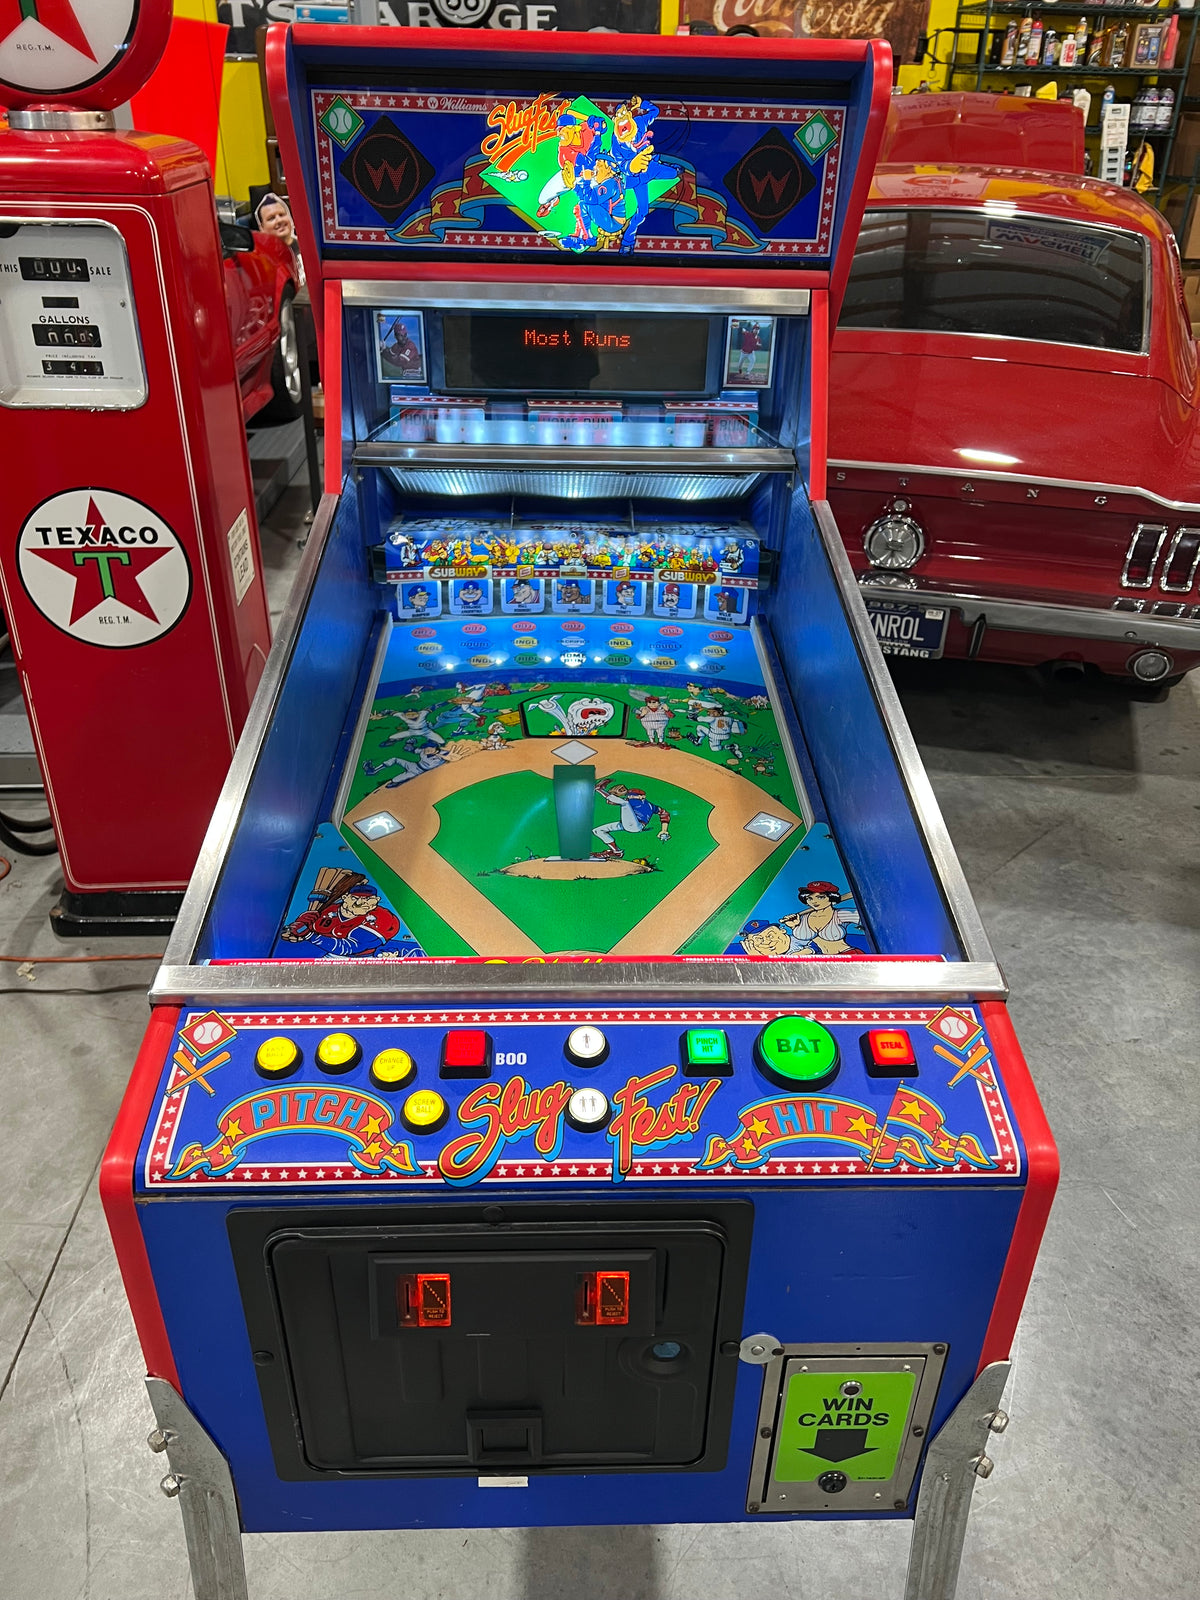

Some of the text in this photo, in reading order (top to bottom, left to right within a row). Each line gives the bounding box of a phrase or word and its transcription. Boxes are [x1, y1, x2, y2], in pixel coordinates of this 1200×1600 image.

[439, 96, 488, 111] Williams
[90, 267, 111, 276] SALE
[39, 315, 90, 325] GALLONS
[524, 329, 631, 348] Most Runs
[719, 419, 745, 432] RUN
[35, 526, 159, 546] TEXACO
[430, 567, 484, 578] SUBWAY
[660, 570, 714, 582] SUBWAY
[869, 612, 925, 642] NROL
[695, 1037, 719, 1046] PINCH
[775, 1038, 821, 1055] BAT
[879, 1041, 904, 1050] STEAL
[701, 1045, 714, 1054] HIT
[379, 1057, 404, 1065] CHANGE
[494, 1052, 528, 1066] BOO
[413, 1098, 436, 1106] SCREW
[250, 1091, 369, 1131] PITCH
[415, 1105, 432, 1114] BALL
[772, 1102, 838, 1135] HIT
[822, 1397, 874, 1411] WIN
[798, 1412, 890, 1427] CARDS
